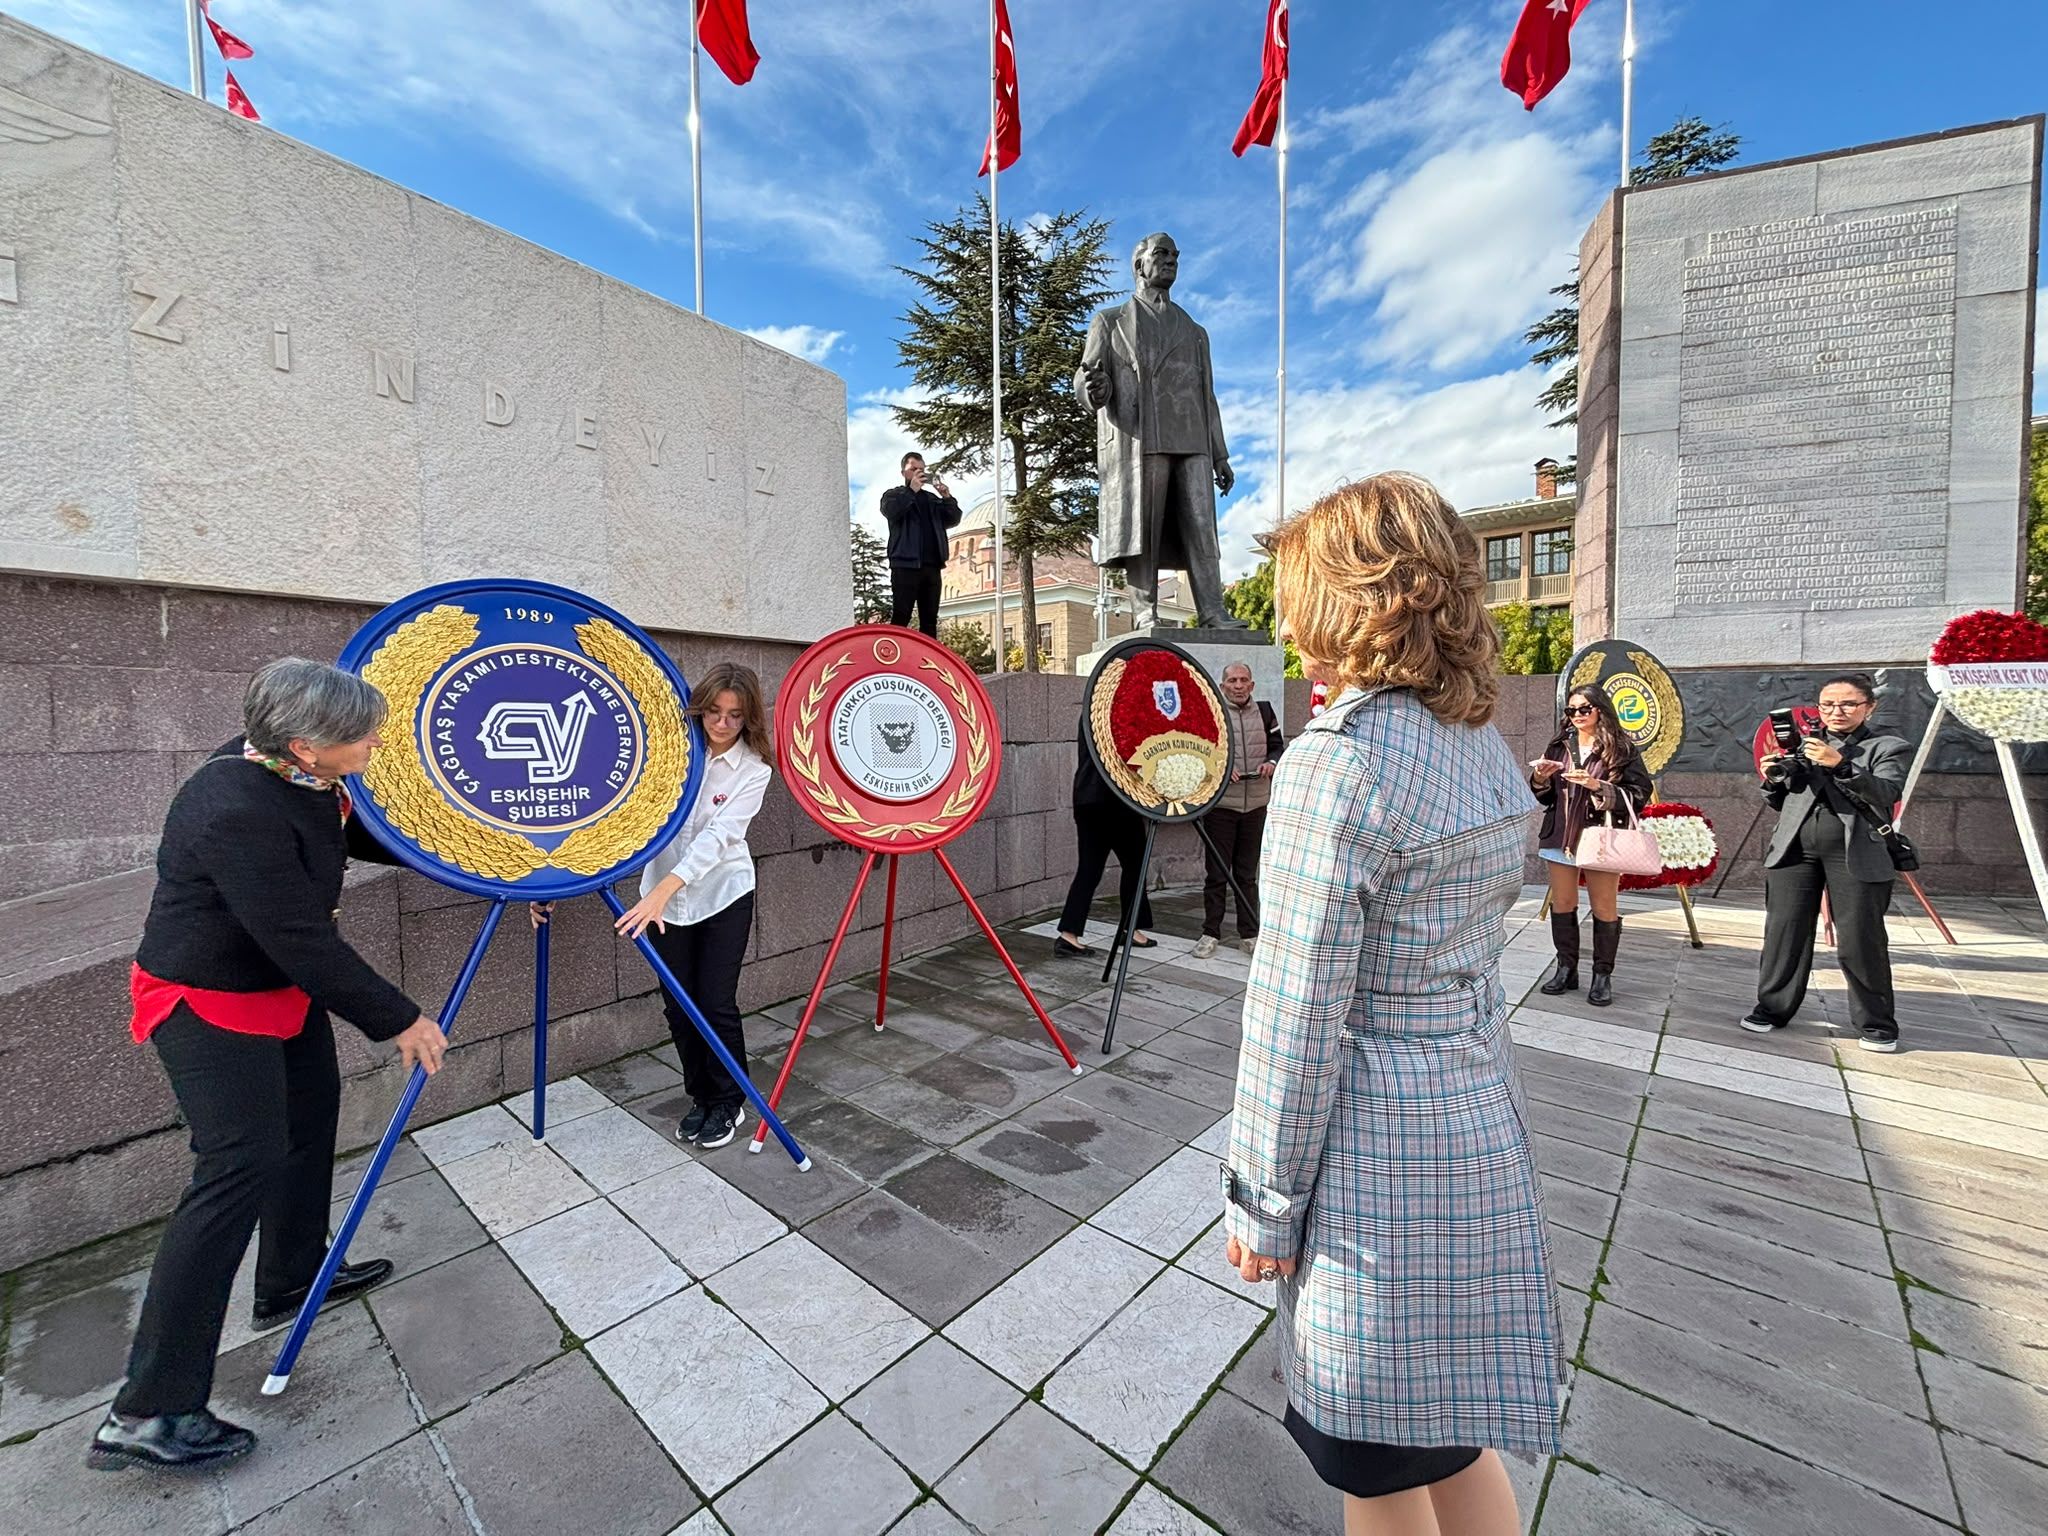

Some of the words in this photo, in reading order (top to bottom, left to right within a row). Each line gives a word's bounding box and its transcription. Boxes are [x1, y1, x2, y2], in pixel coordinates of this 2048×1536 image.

[503, 606, 555, 625] 1989
[439, 658, 498, 711] YAŞAMI
[501, 652, 620, 710] DESTEKLEME
[1949, 666, 2003, 686] ESKİŞEHİR
[2001, 668, 2030, 684] KENT
[839, 684, 872, 747] ATATÜRKÇÜ
[875, 678, 927, 702] DÜŞÜNCE
[437, 717, 481, 794] ÇAĞDAŞ
[1143, 741, 1171, 760] GARNİZON
[490, 783, 591, 806] ESKİŞEHİR
[864, 773, 910, 794] ESKİŞEHİR
[911, 773, 935, 792] ŞUBE
[508, 801, 578, 823] ŞUBESİ
